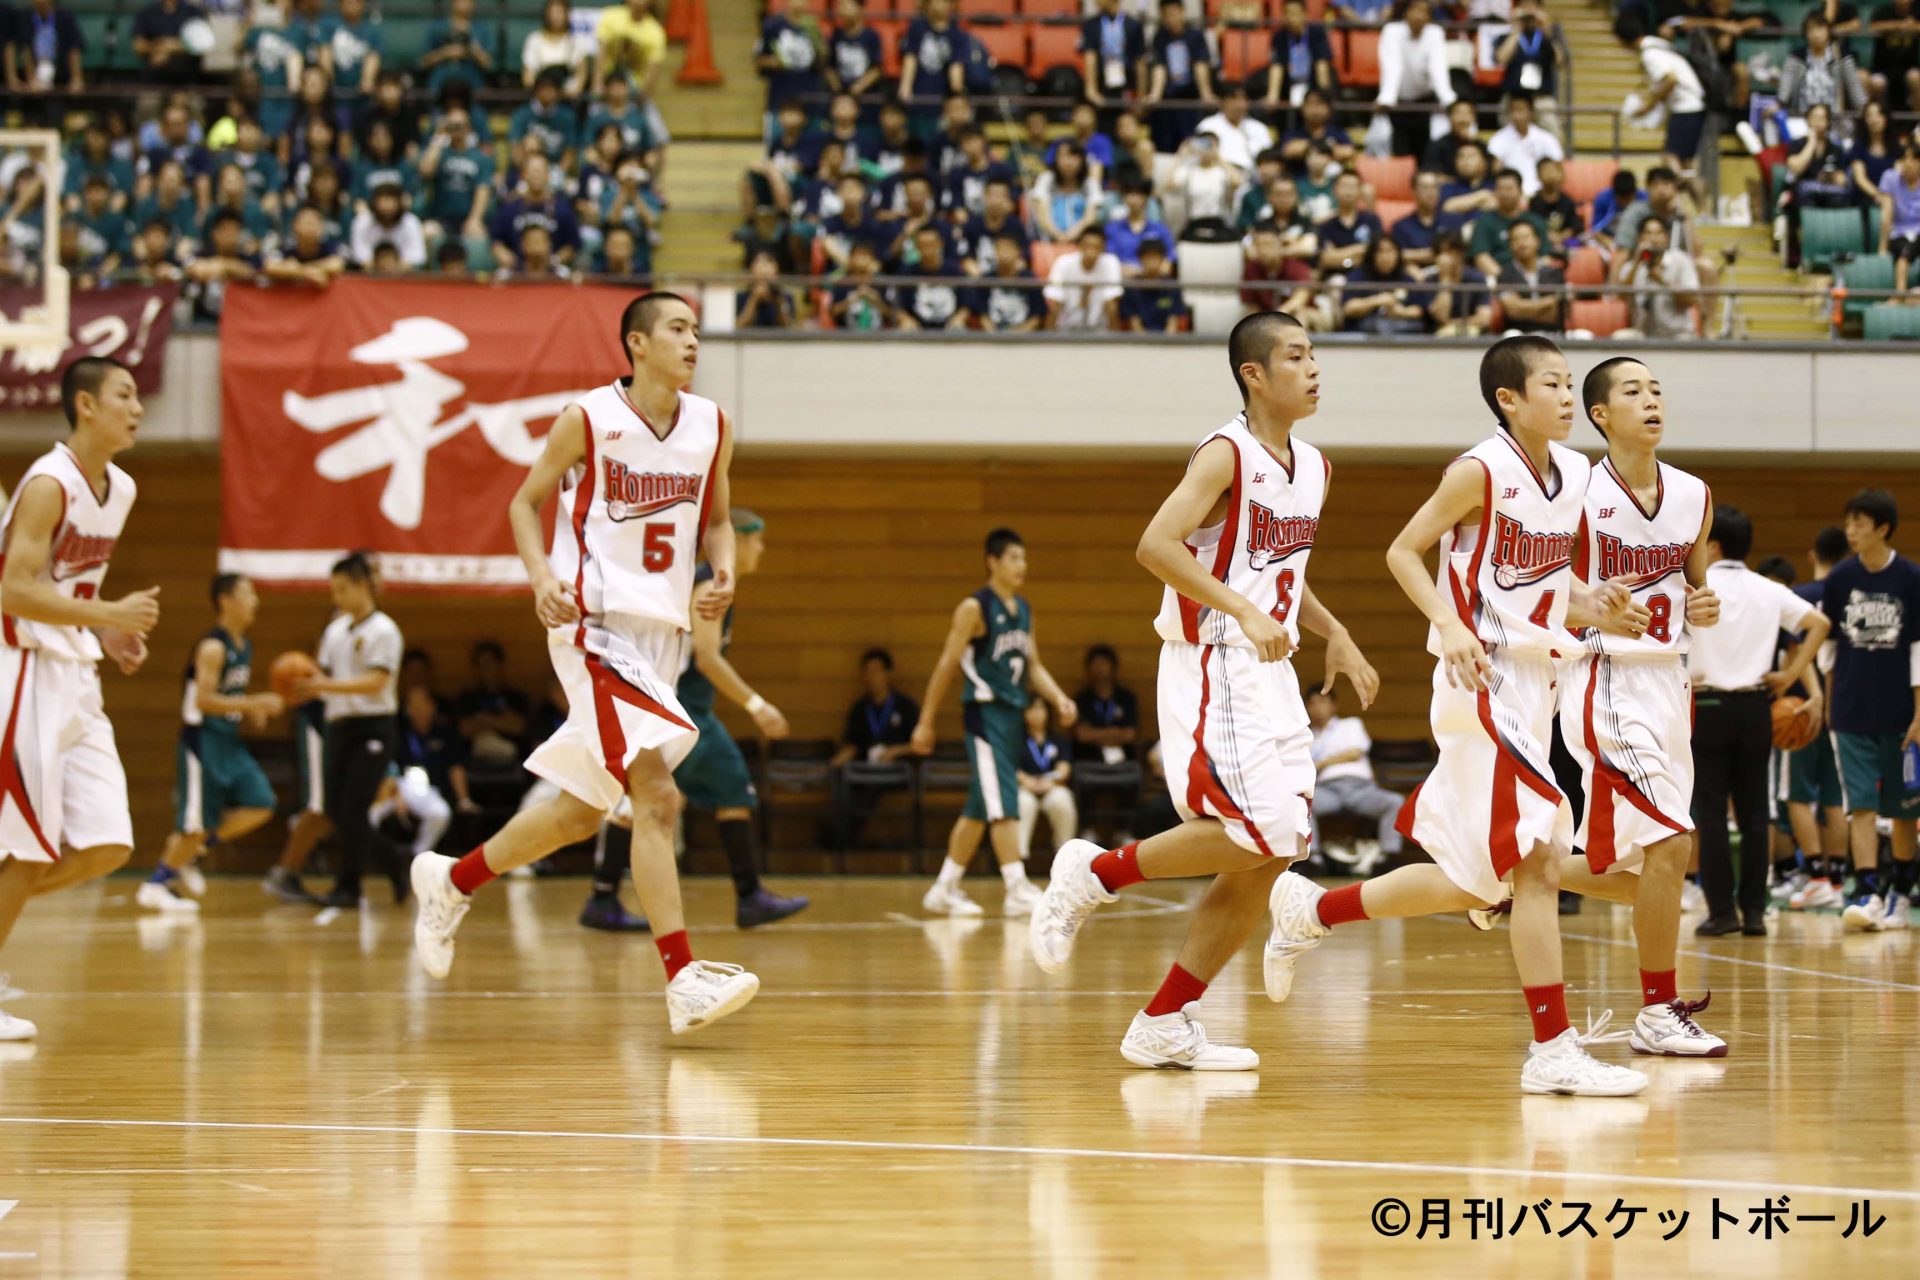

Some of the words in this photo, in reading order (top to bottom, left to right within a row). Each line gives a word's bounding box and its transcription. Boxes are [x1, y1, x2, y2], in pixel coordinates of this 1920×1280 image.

[283, 316, 590, 530] 和
[1502, 487, 1520, 499] BF
[1597, 507, 1616, 519] BF
[642, 523, 675, 573] 5
[1528, 589, 1556, 630] 4
[1645, 593, 1672, 644] 8
[1009, 657, 1024, 687] 7
